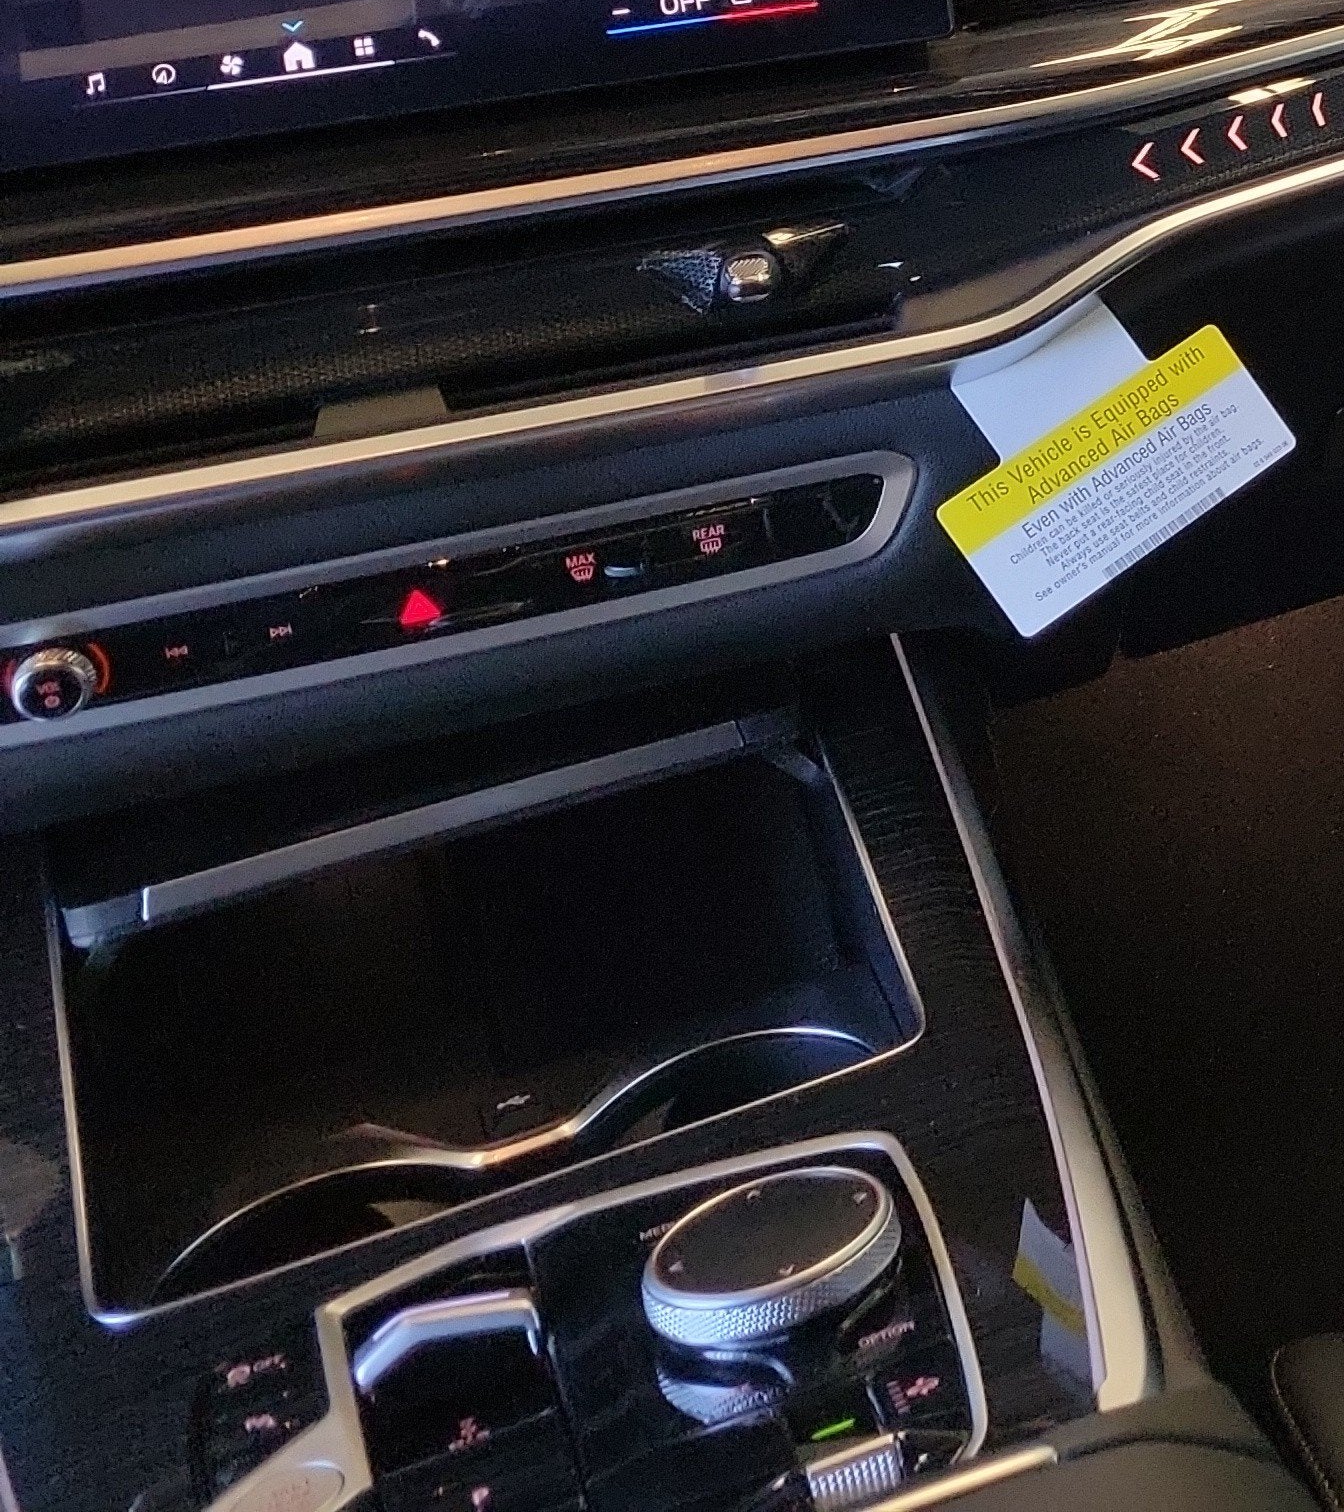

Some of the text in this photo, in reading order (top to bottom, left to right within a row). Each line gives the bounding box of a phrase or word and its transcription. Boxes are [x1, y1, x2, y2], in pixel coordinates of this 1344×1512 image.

[966, 342, 1206, 514] This Vehicle is Equipped with
[1009, 401, 1240, 565] Children can be killed or seriously injured by the air bag.
[1021, 399, 1214, 539] Even with Advanced Air Bags
[1023, 388, 1182, 504] Advanced Air Bags
[692, 524, 725, 541] REAR
[1033, 584, 1054, 602] See
[1052, 560, 1088, 589] owner's
[1087, 536, 1121, 564] manual
[1119, 526, 1136, 541] for
[1134, 511, 1158, 531] more
[1156, 476, 1206, 515] information
[1203, 459, 1230, 481] about
[1039, 540, 1059, 557] The
[1057, 525, 1080, 545] back
[1079, 511, 1100, 529] seat
[1109, 493, 1126, 508] the
[1124, 475, 1152, 498] safest
[1150, 459, 1176, 480] place
[1173, 449, 1188, 463] for
[1187, 425, 1224, 454] children.
[1045, 543, 1073, 566] Never
[1072, 533, 1090, 549] put
[1095, 494, 1144, 533] rear-facing
[1141, 479, 1165, 499] child
[1164, 466, 1184, 483] seat
[1192, 449, 1208, 464] the
[1058, 544, 1093, 572] Always
[1091, 533, 1109, 548] use
[1108, 519, 1128, 536] seat
[1127, 502, 1151, 522] belts
[1149, 490, 1167, 507] and
[1166, 475, 1189, 495] child
[565, 551, 596, 568] MAX
